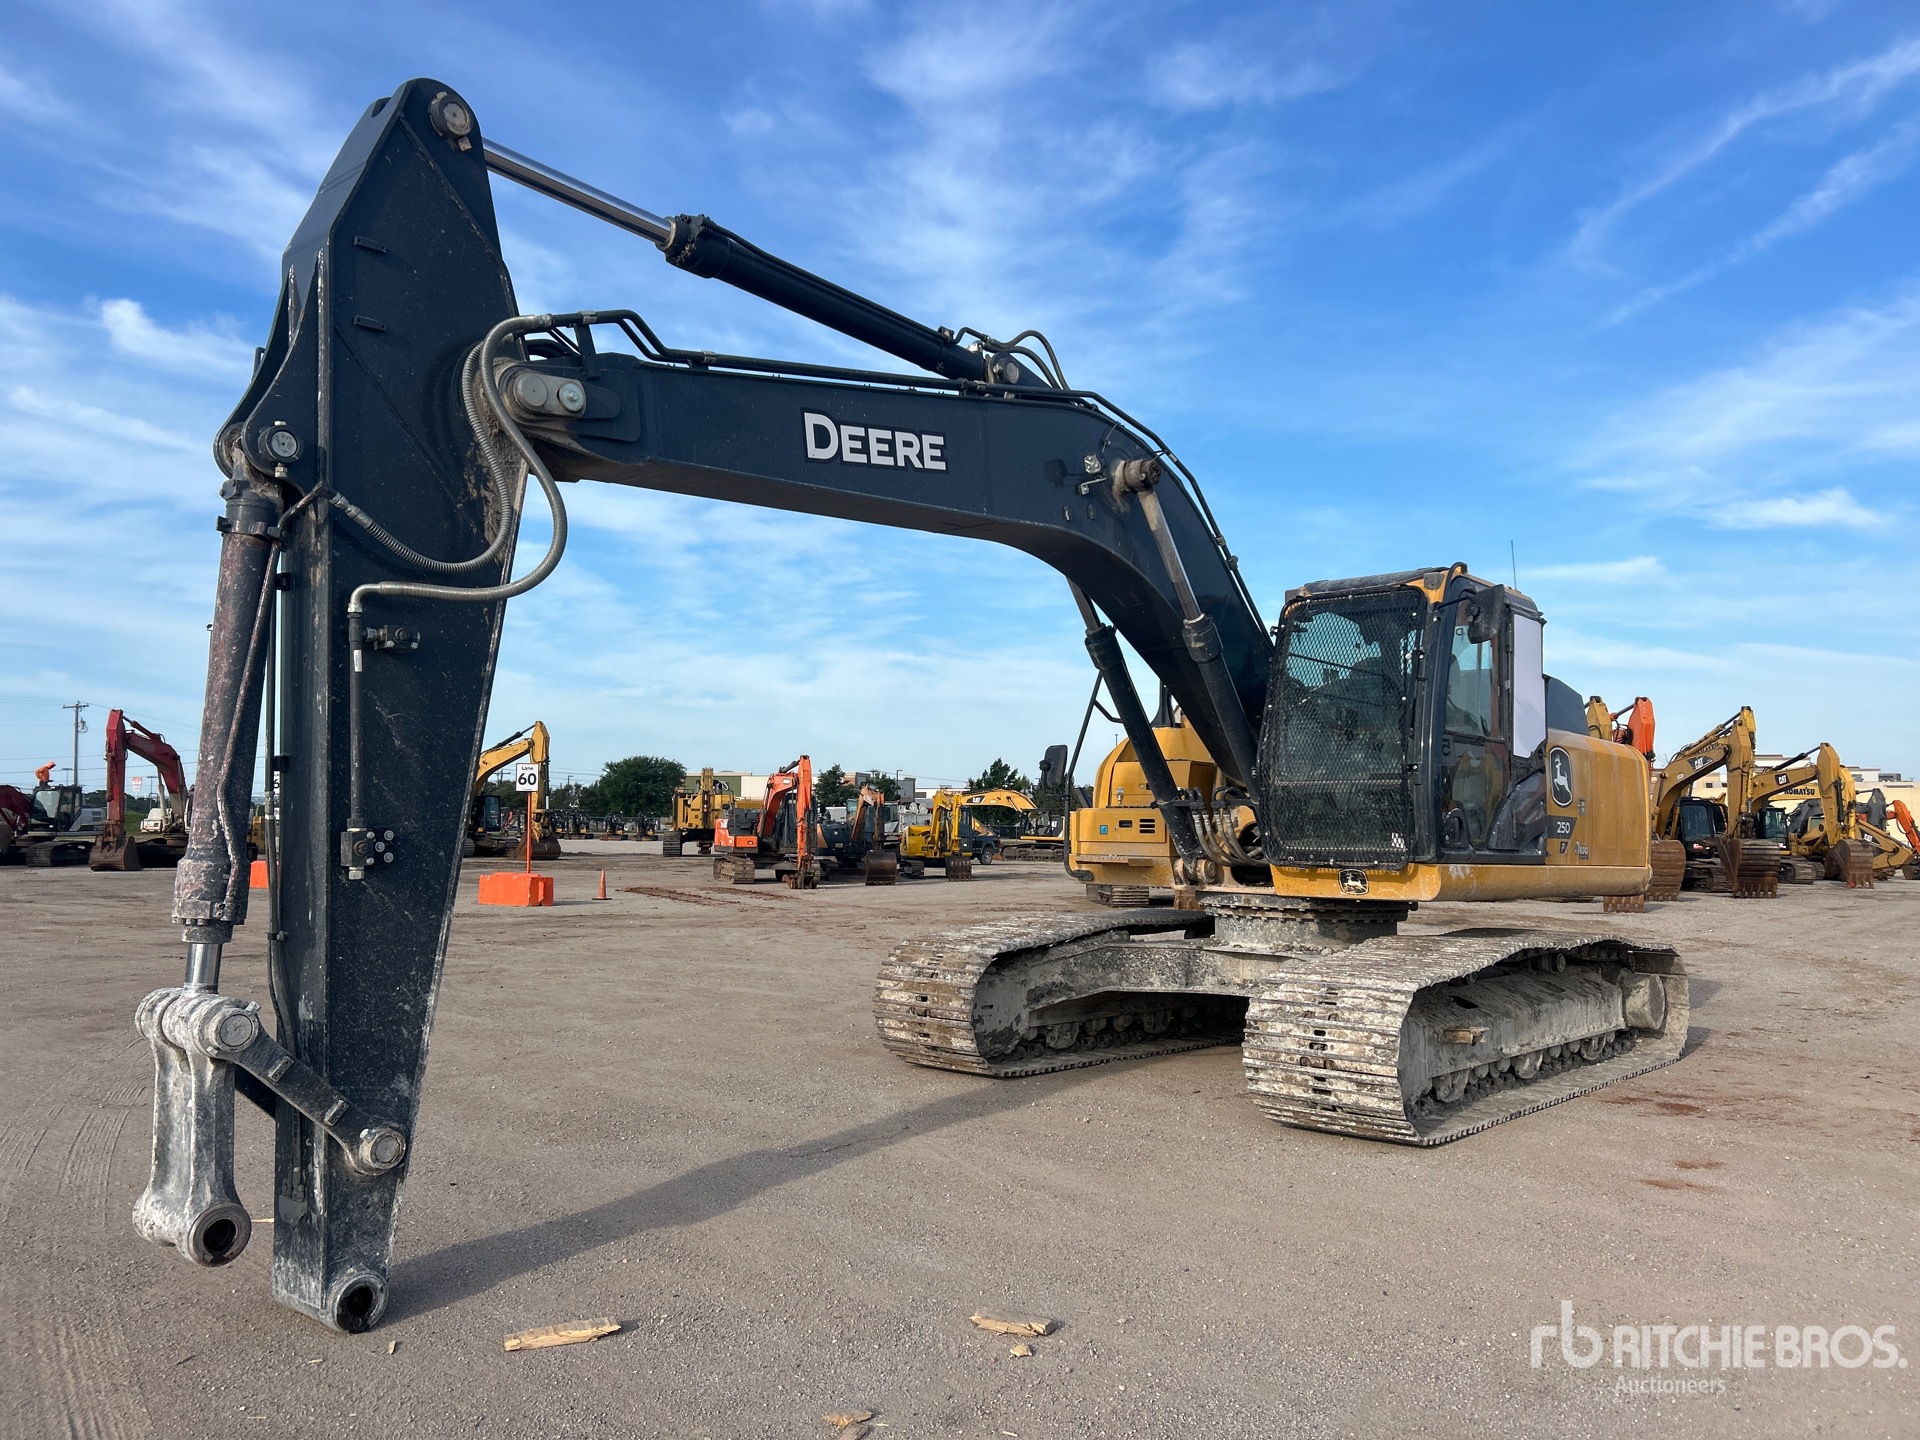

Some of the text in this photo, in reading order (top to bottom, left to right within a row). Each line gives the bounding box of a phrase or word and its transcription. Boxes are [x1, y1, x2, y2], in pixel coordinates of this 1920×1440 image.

[804, 412, 946, 471] DEERE
[518, 773, 537, 786] 60
[1556, 821, 1571, 834] 250
